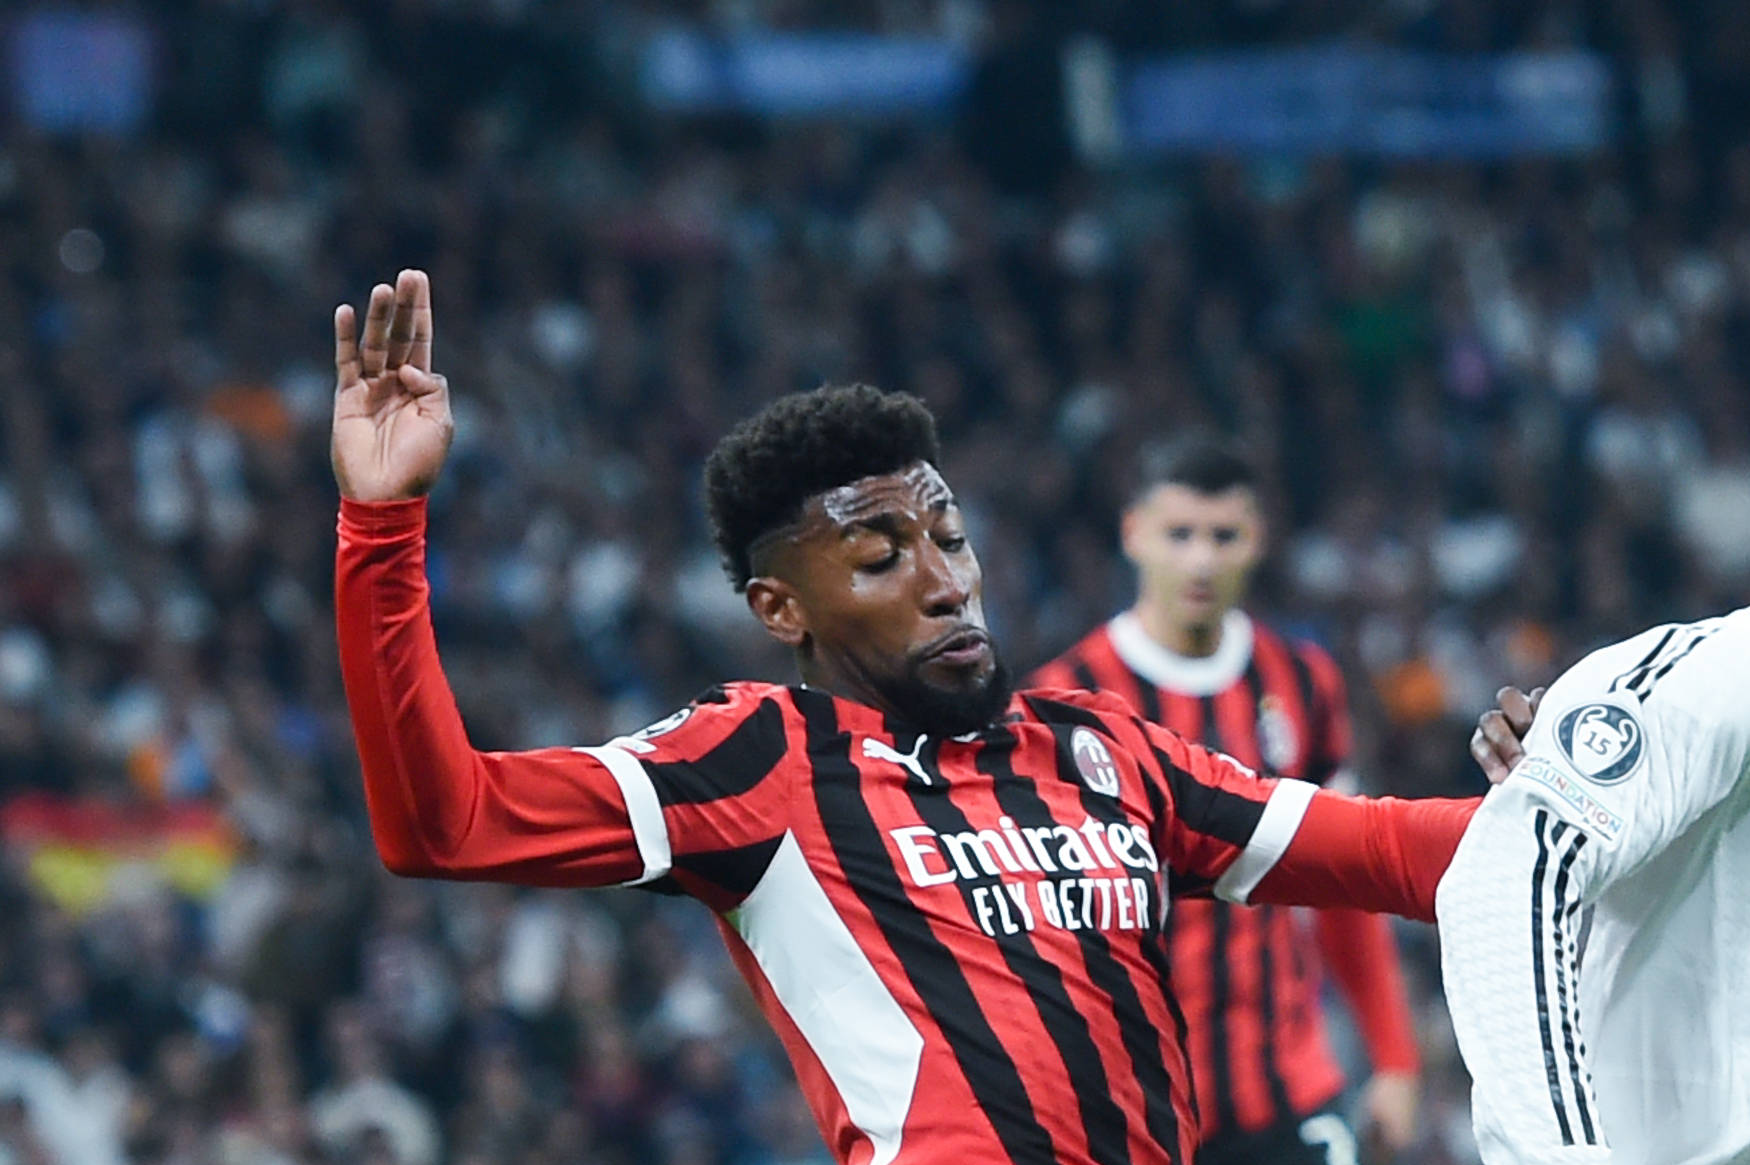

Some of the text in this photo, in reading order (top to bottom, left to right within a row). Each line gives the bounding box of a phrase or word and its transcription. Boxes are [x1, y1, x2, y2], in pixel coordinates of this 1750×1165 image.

[1582, 730, 1612, 757] 15
[888, 815, 1159, 888] Emirates
[972, 877, 1151, 937] FLY BETTER
